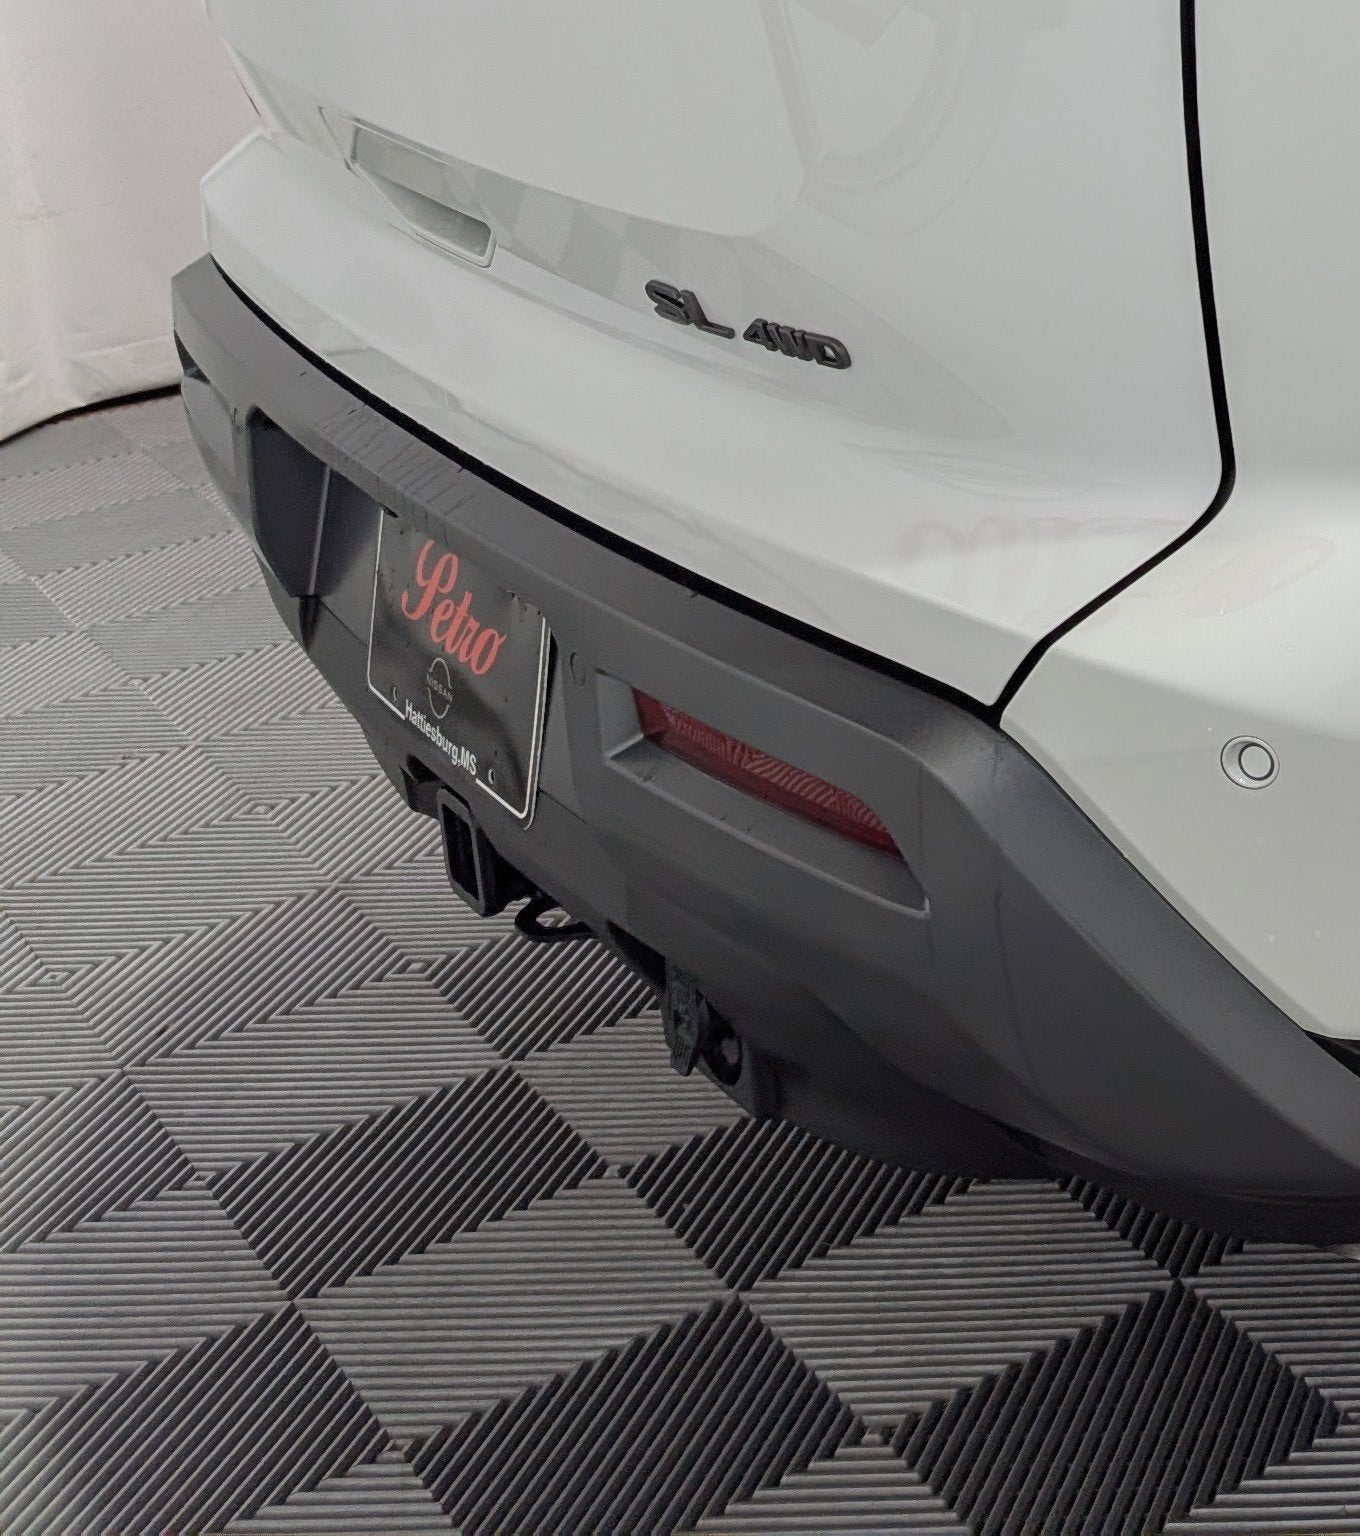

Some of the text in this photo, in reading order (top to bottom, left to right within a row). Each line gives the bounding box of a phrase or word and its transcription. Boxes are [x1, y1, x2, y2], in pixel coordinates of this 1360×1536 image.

[644, 278, 852, 370] SL 4WD
[401, 539, 508, 677] Petro
